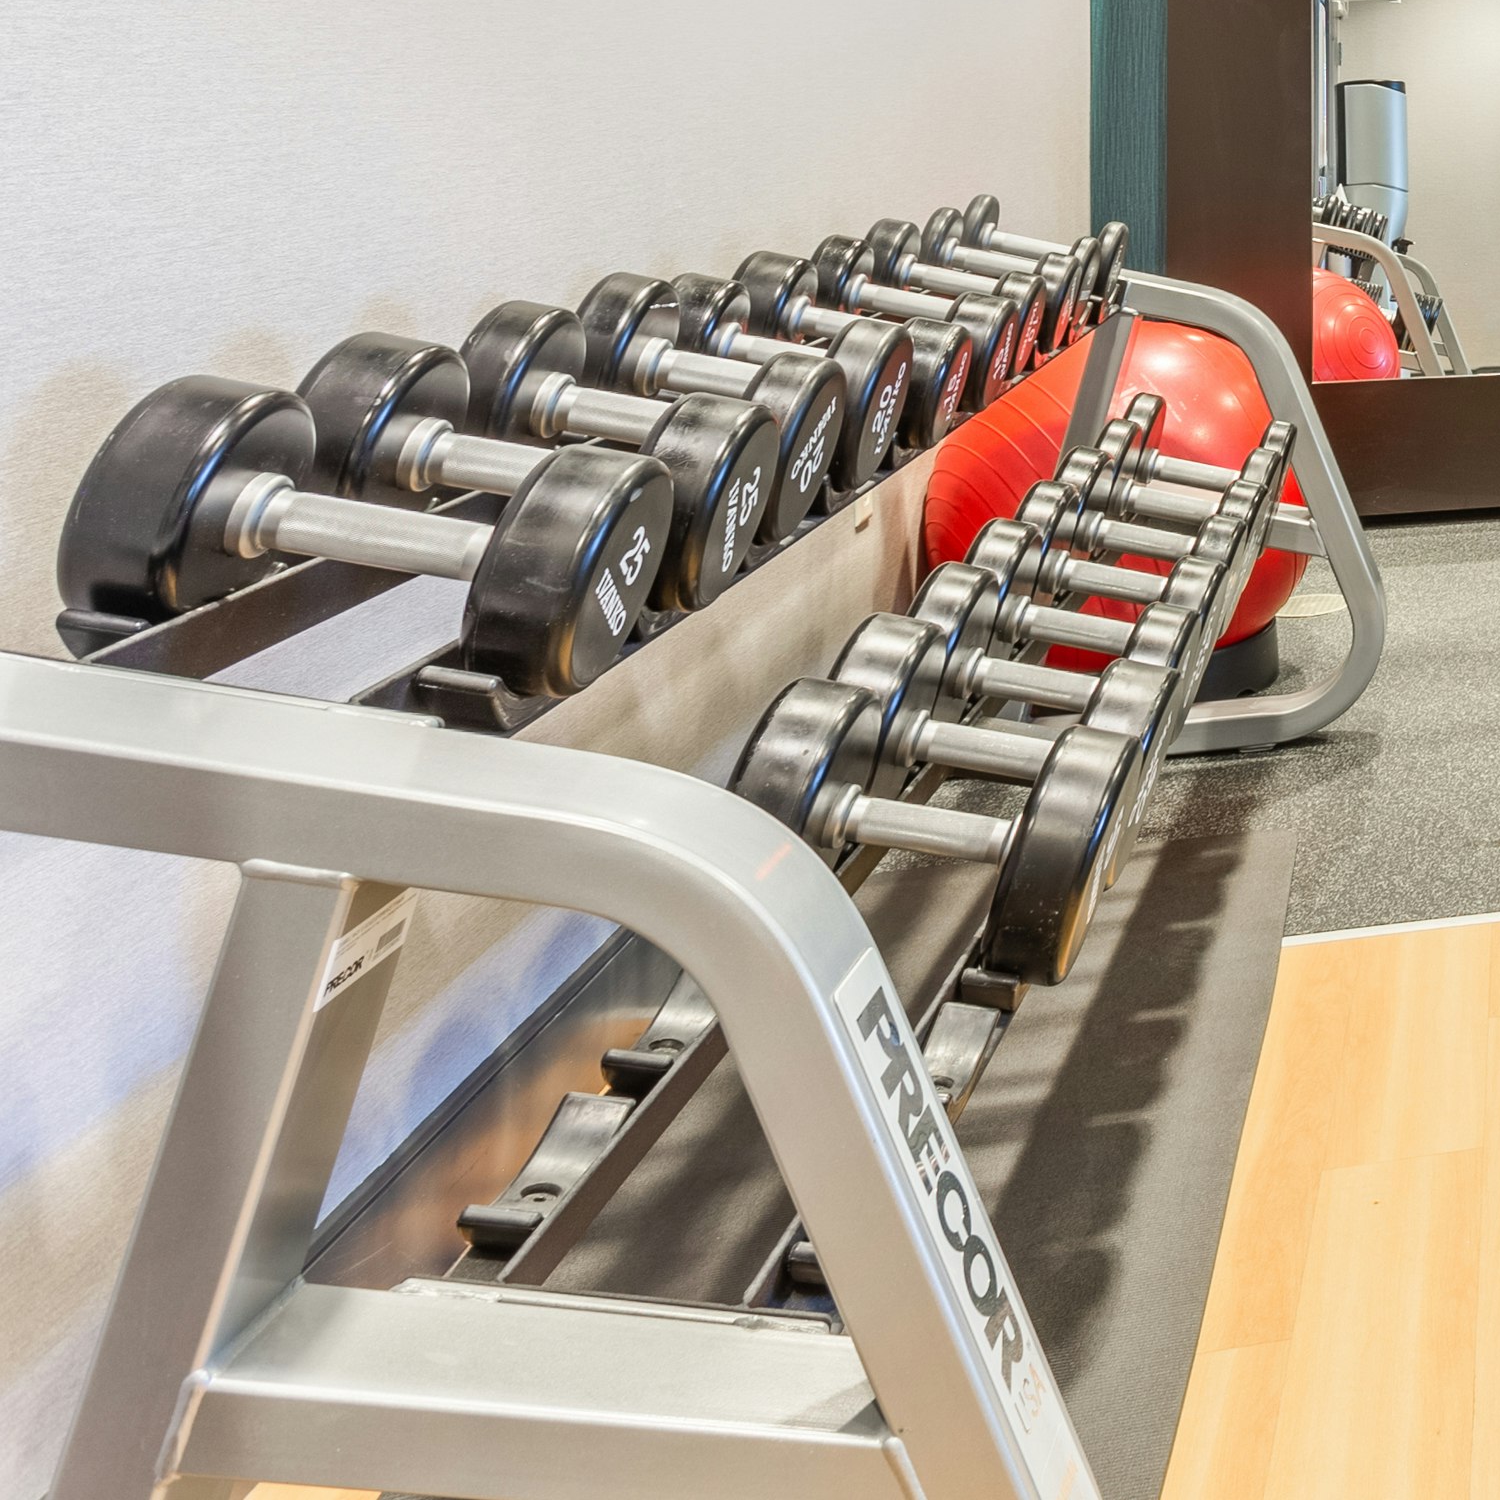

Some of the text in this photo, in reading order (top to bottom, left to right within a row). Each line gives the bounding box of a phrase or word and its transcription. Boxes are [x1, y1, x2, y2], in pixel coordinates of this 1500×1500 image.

[790, 395, 837, 480] IVANKO
[871, 384, 893, 434] 20
[874, 361, 907, 455] IVANKO
[721, 476, 741, 573] IVANKO
[740, 466, 762, 527] 25
[618, 525, 651, 586] 25
[594, 567, 627, 637] IVANKO
[857, 986, 1024, 1394] PRECOR
